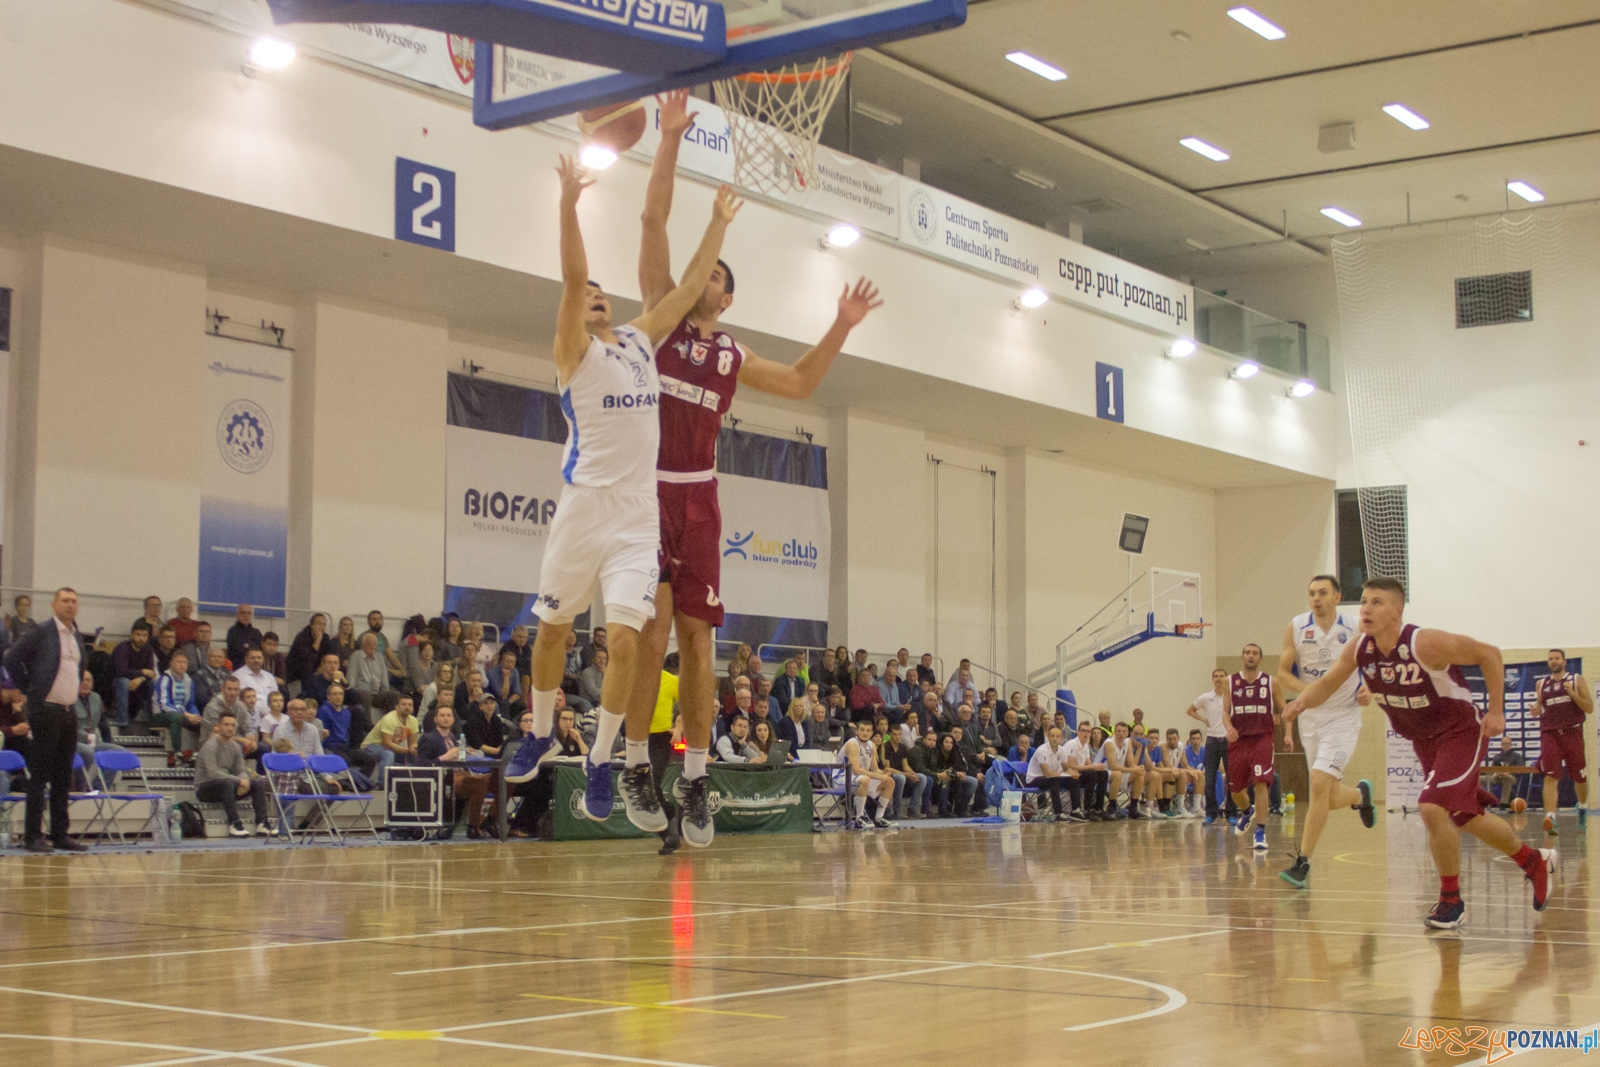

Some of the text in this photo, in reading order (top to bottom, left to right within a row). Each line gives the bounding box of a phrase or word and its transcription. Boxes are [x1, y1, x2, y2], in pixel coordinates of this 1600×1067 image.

[375, 25, 427, 54] Wyższego
[818, 165, 882, 195] Ministerstwo Nauki
[412, 171, 441, 239] 2
[822, 182, 861, 203] Szkolnictwa
[863, 196, 894, 215] Wyższego
[945, 206, 1009, 242] Centrum Sportu
[945, 230, 1039, 279] Politechniki Poznańskiej
[1059, 258, 1187, 325] cspp.put.poznan.pl
[717, 350, 734, 376] 8
[1105, 371, 1116, 416] 1
[473, 521, 543, 537] POLSKI PRODUCENT
[752, 533, 818, 560] funclub
[753, 553, 817, 569] biuro podróży
[1395, 662, 1423, 685] 22
[1259, 686, 1268, 699] 9
[1254, 764, 1262, 776] 9
